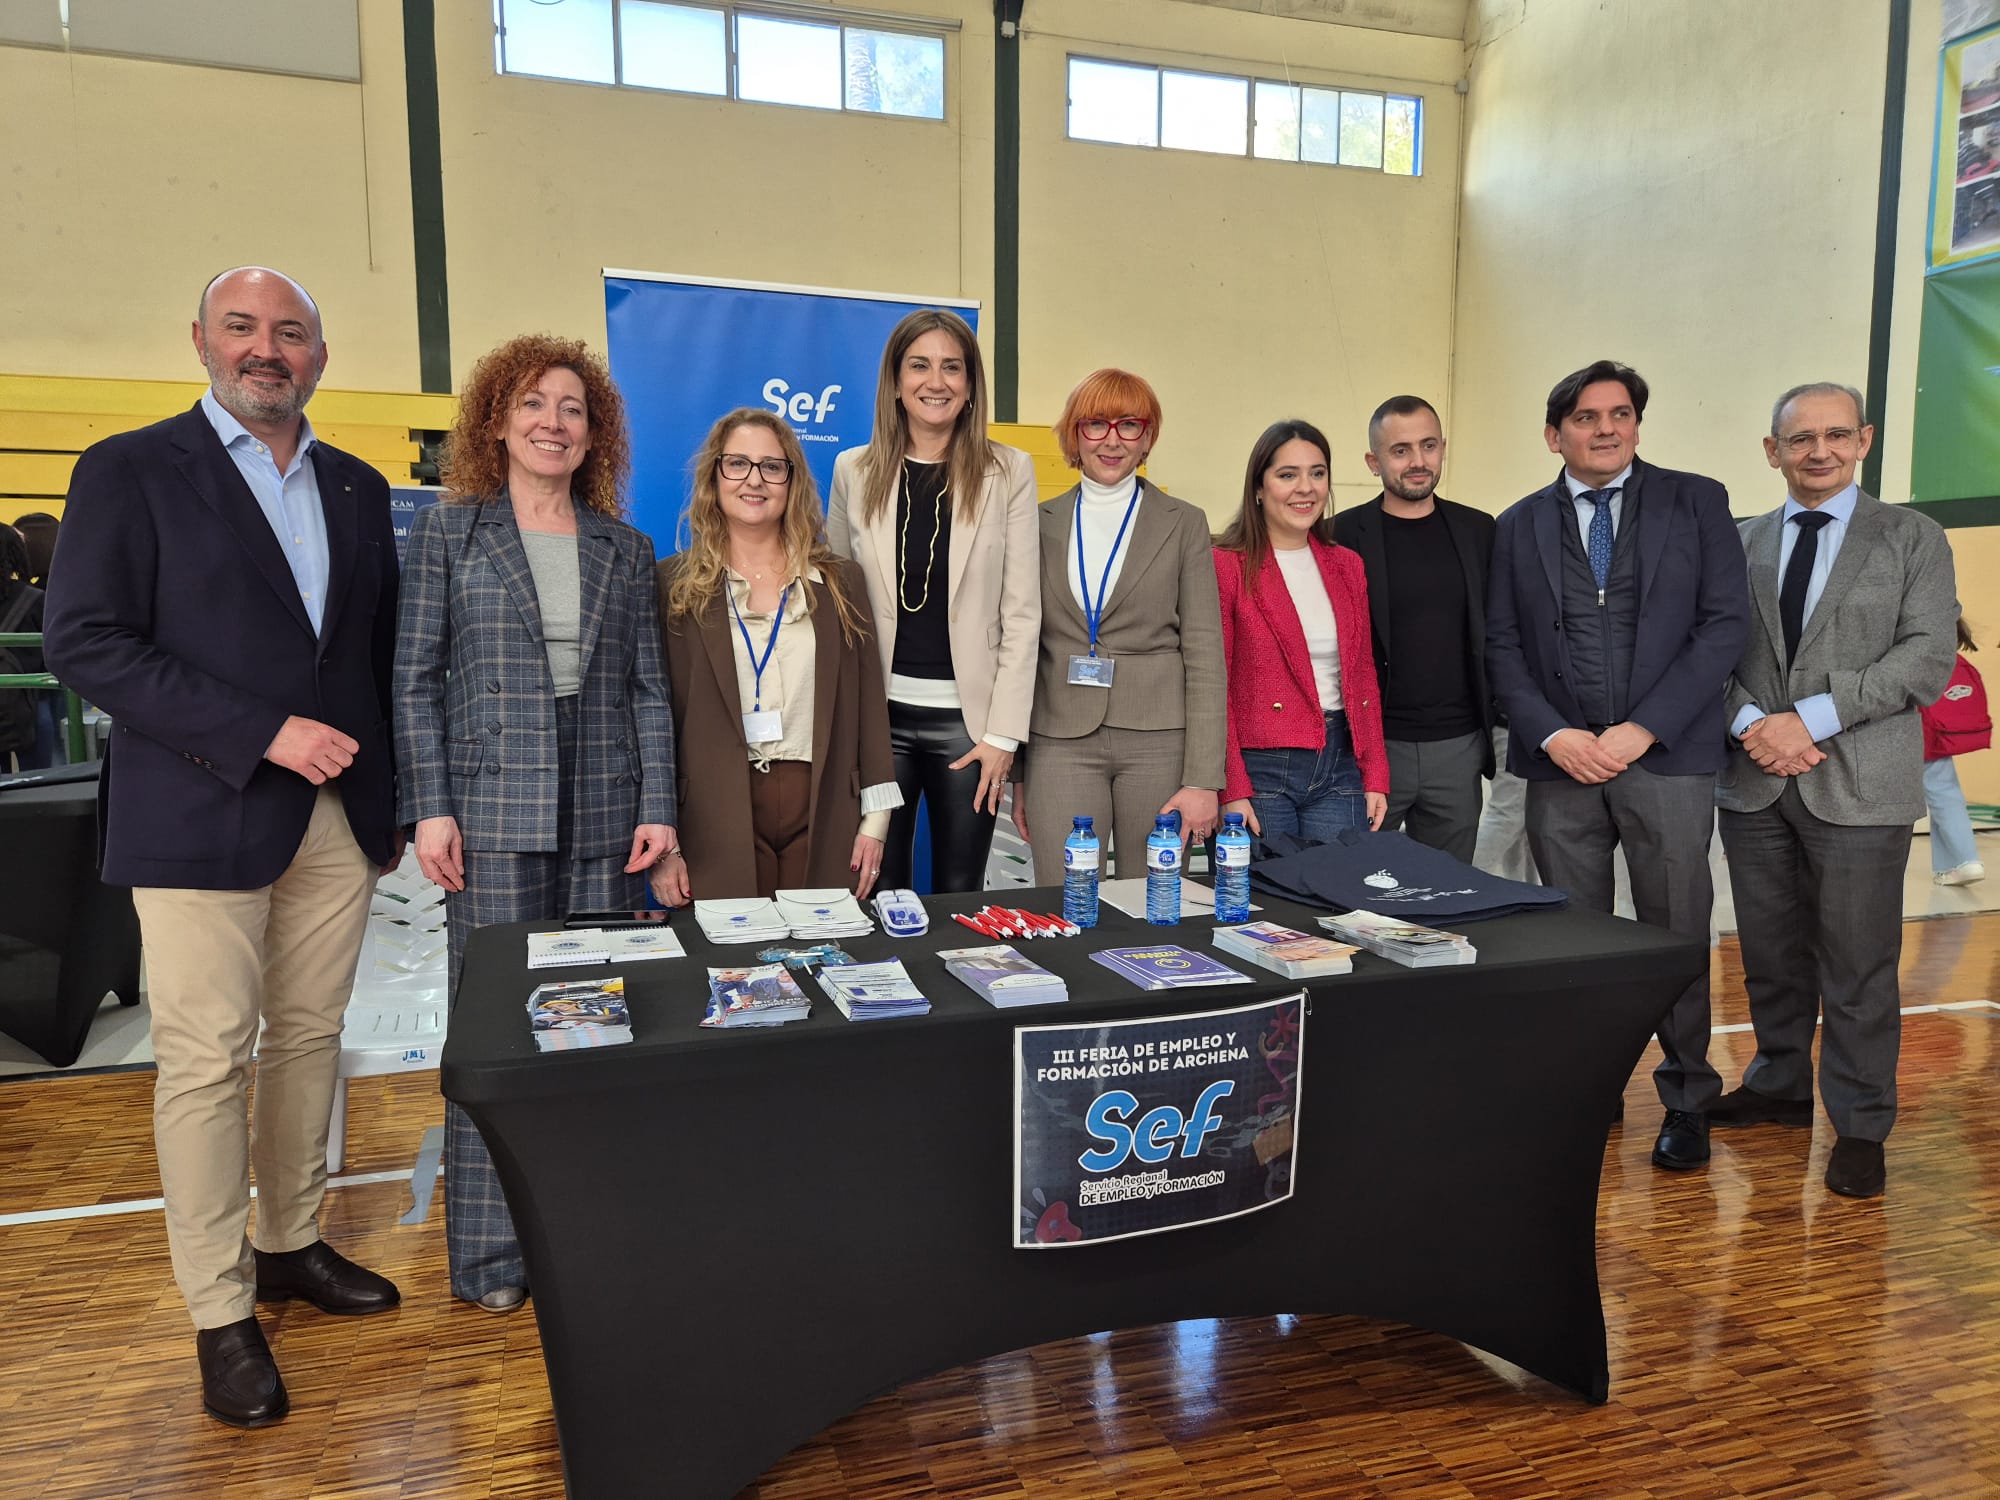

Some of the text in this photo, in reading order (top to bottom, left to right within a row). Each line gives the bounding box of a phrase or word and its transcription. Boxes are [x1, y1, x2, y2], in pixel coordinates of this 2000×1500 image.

[762, 377, 842, 423] Sef
[802, 434, 839, 442] FORMACIÓN
[391, 500, 414, 508] CAM
[1037, 1046, 1249, 1082] FORMACIÓN DE ARCHENA
[1053, 1032, 1237, 1064] III FERIA DE EMPLEO Y
[1078, 1080, 1235, 1173] Sef
[1080, 1171, 1225, 1206] DE EMPLEO y FORMACIÓN
[1081, 1169, 1168, 1192] Servicio Regional
